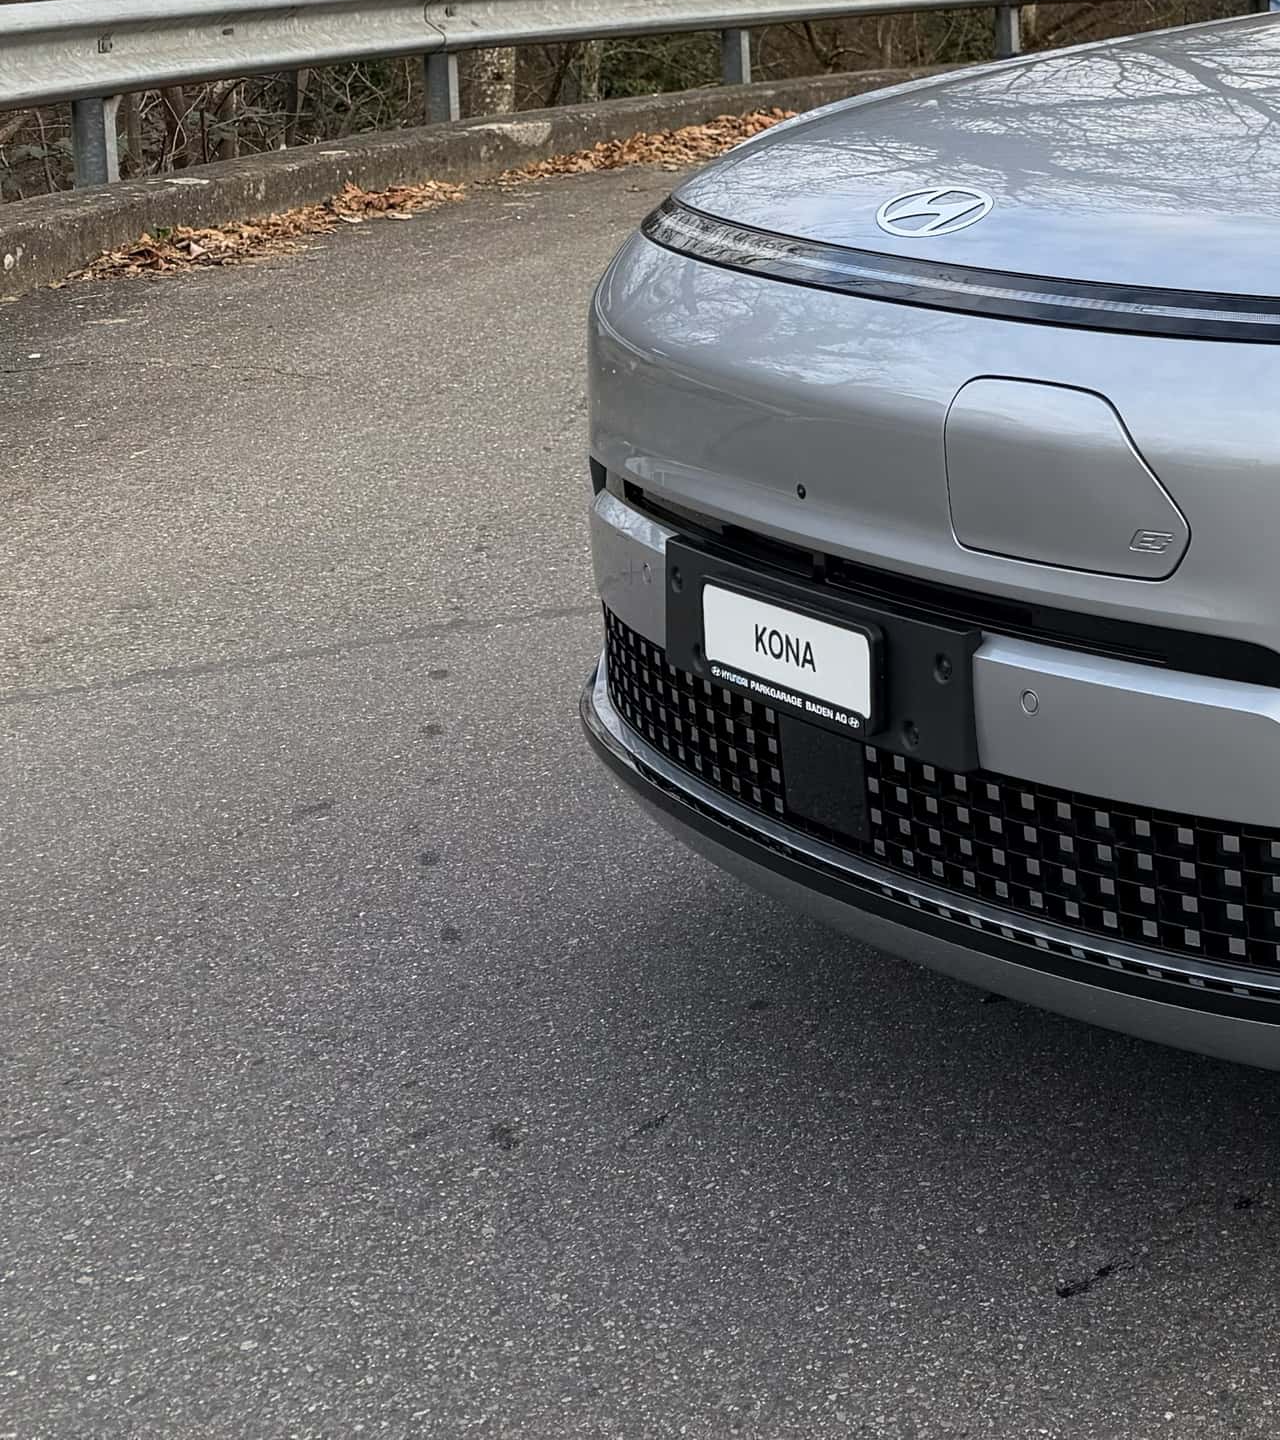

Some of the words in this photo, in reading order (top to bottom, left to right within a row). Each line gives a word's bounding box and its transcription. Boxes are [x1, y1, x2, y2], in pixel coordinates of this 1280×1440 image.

[755, 623, 816, 673] KONA
[750, 680, 802, 708] PARKGARAGE
[805, 700, 834, 720] BADEN
[835, 711, 848, 725] AG
